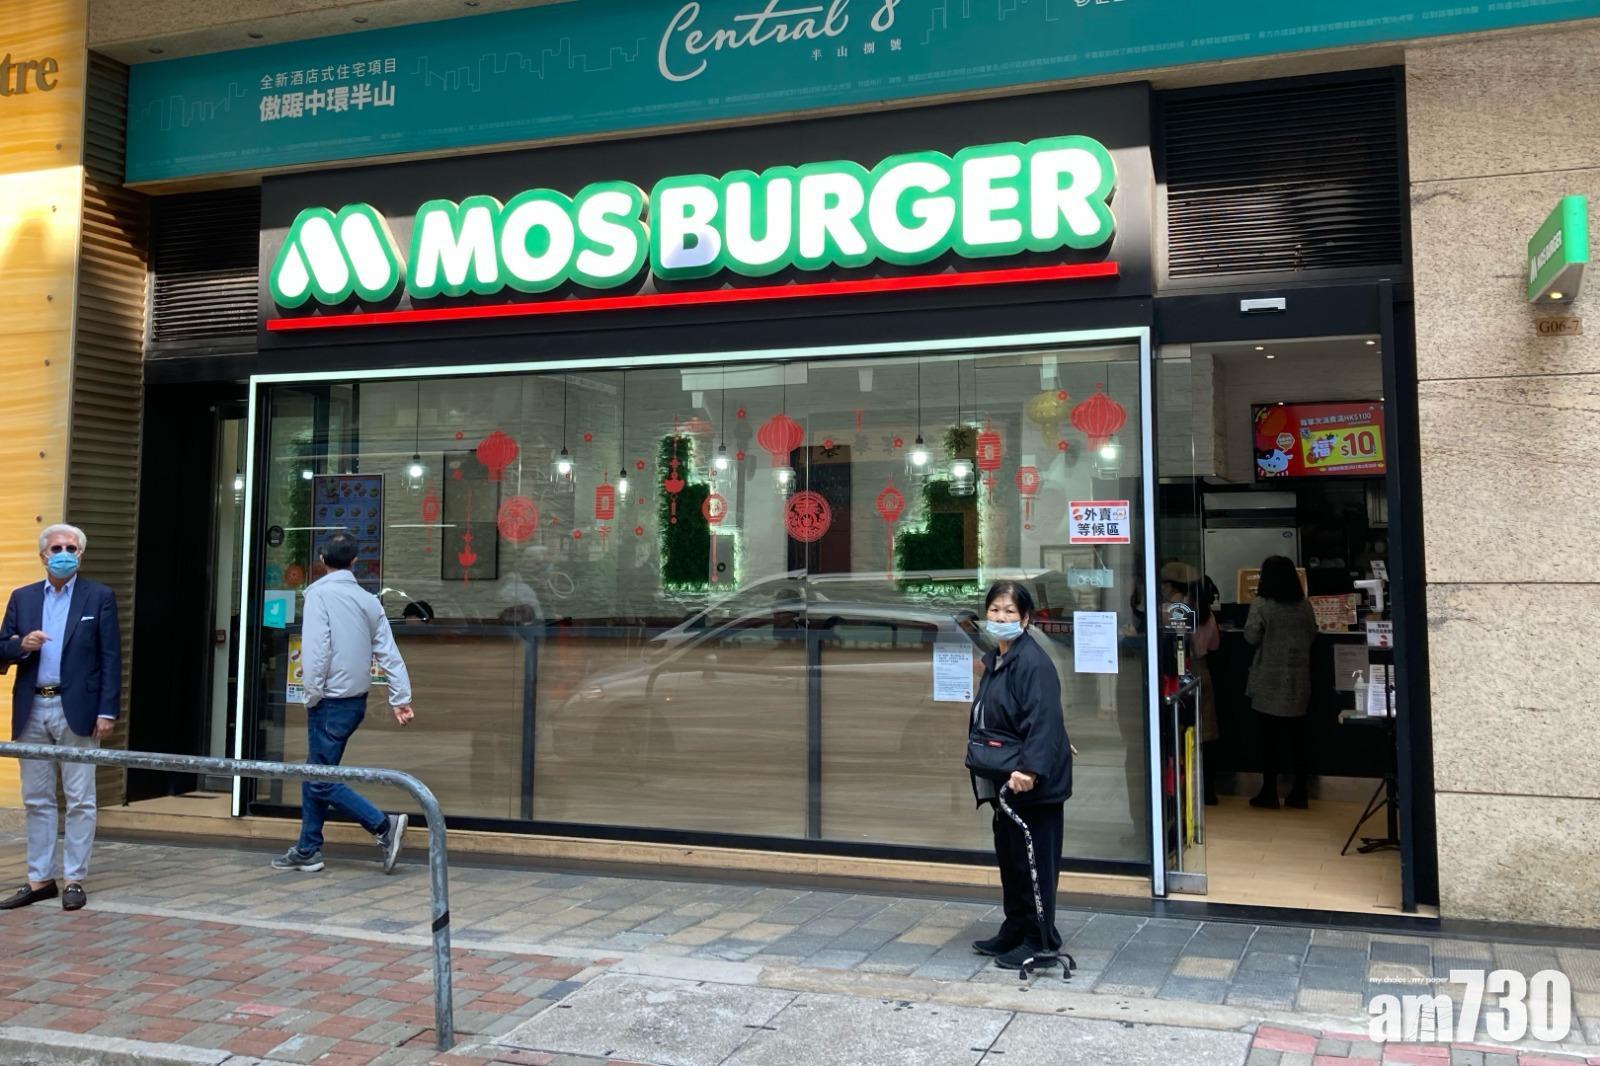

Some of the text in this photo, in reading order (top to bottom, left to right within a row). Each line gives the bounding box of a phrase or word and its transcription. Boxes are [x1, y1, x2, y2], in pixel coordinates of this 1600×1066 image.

[658, 0, 850, 82] Central
[260, 57, 396, 90] 全新酒店式住宅項目
[259, 80, 396, 122] 傲踞中環半山
[415, 147, 1102, 288] MOS BURGER
[1077, 522, 1120, 536] 等候區
[1084, 507, 1111, 521] 外賣
